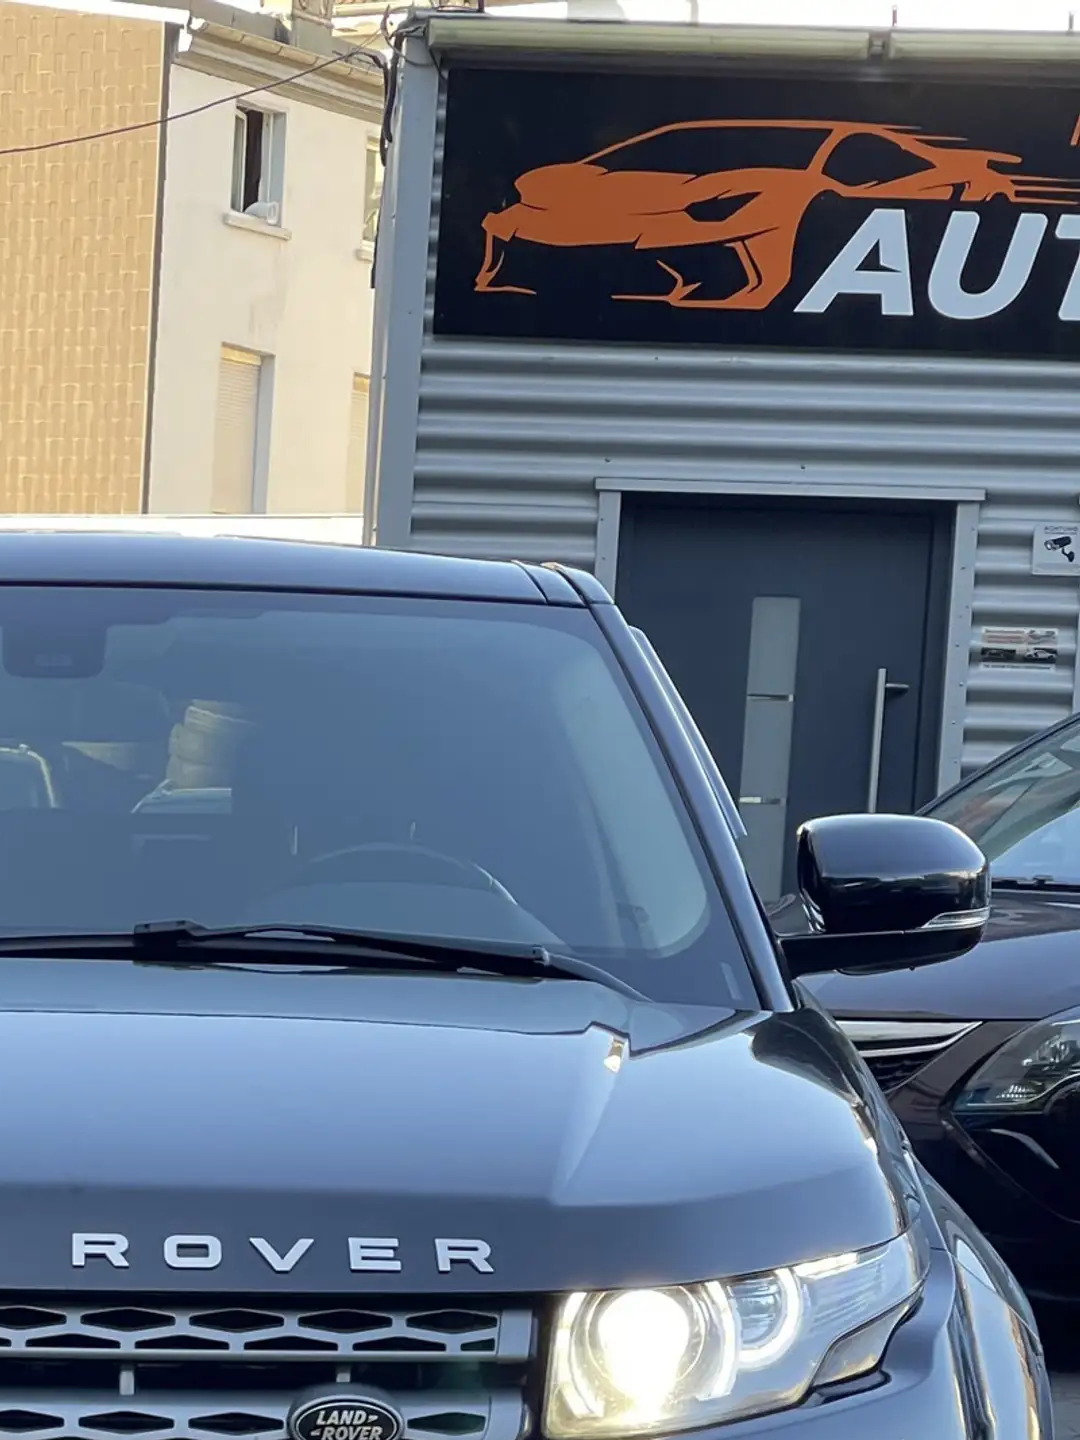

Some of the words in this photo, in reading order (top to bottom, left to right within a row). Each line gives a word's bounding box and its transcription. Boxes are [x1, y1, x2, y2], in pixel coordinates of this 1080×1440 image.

[72, 1232, 495, 1273] ROVER
[316, 1410, 367, 1425] LAND
[321, 1426, 383, 1440] ROVER
